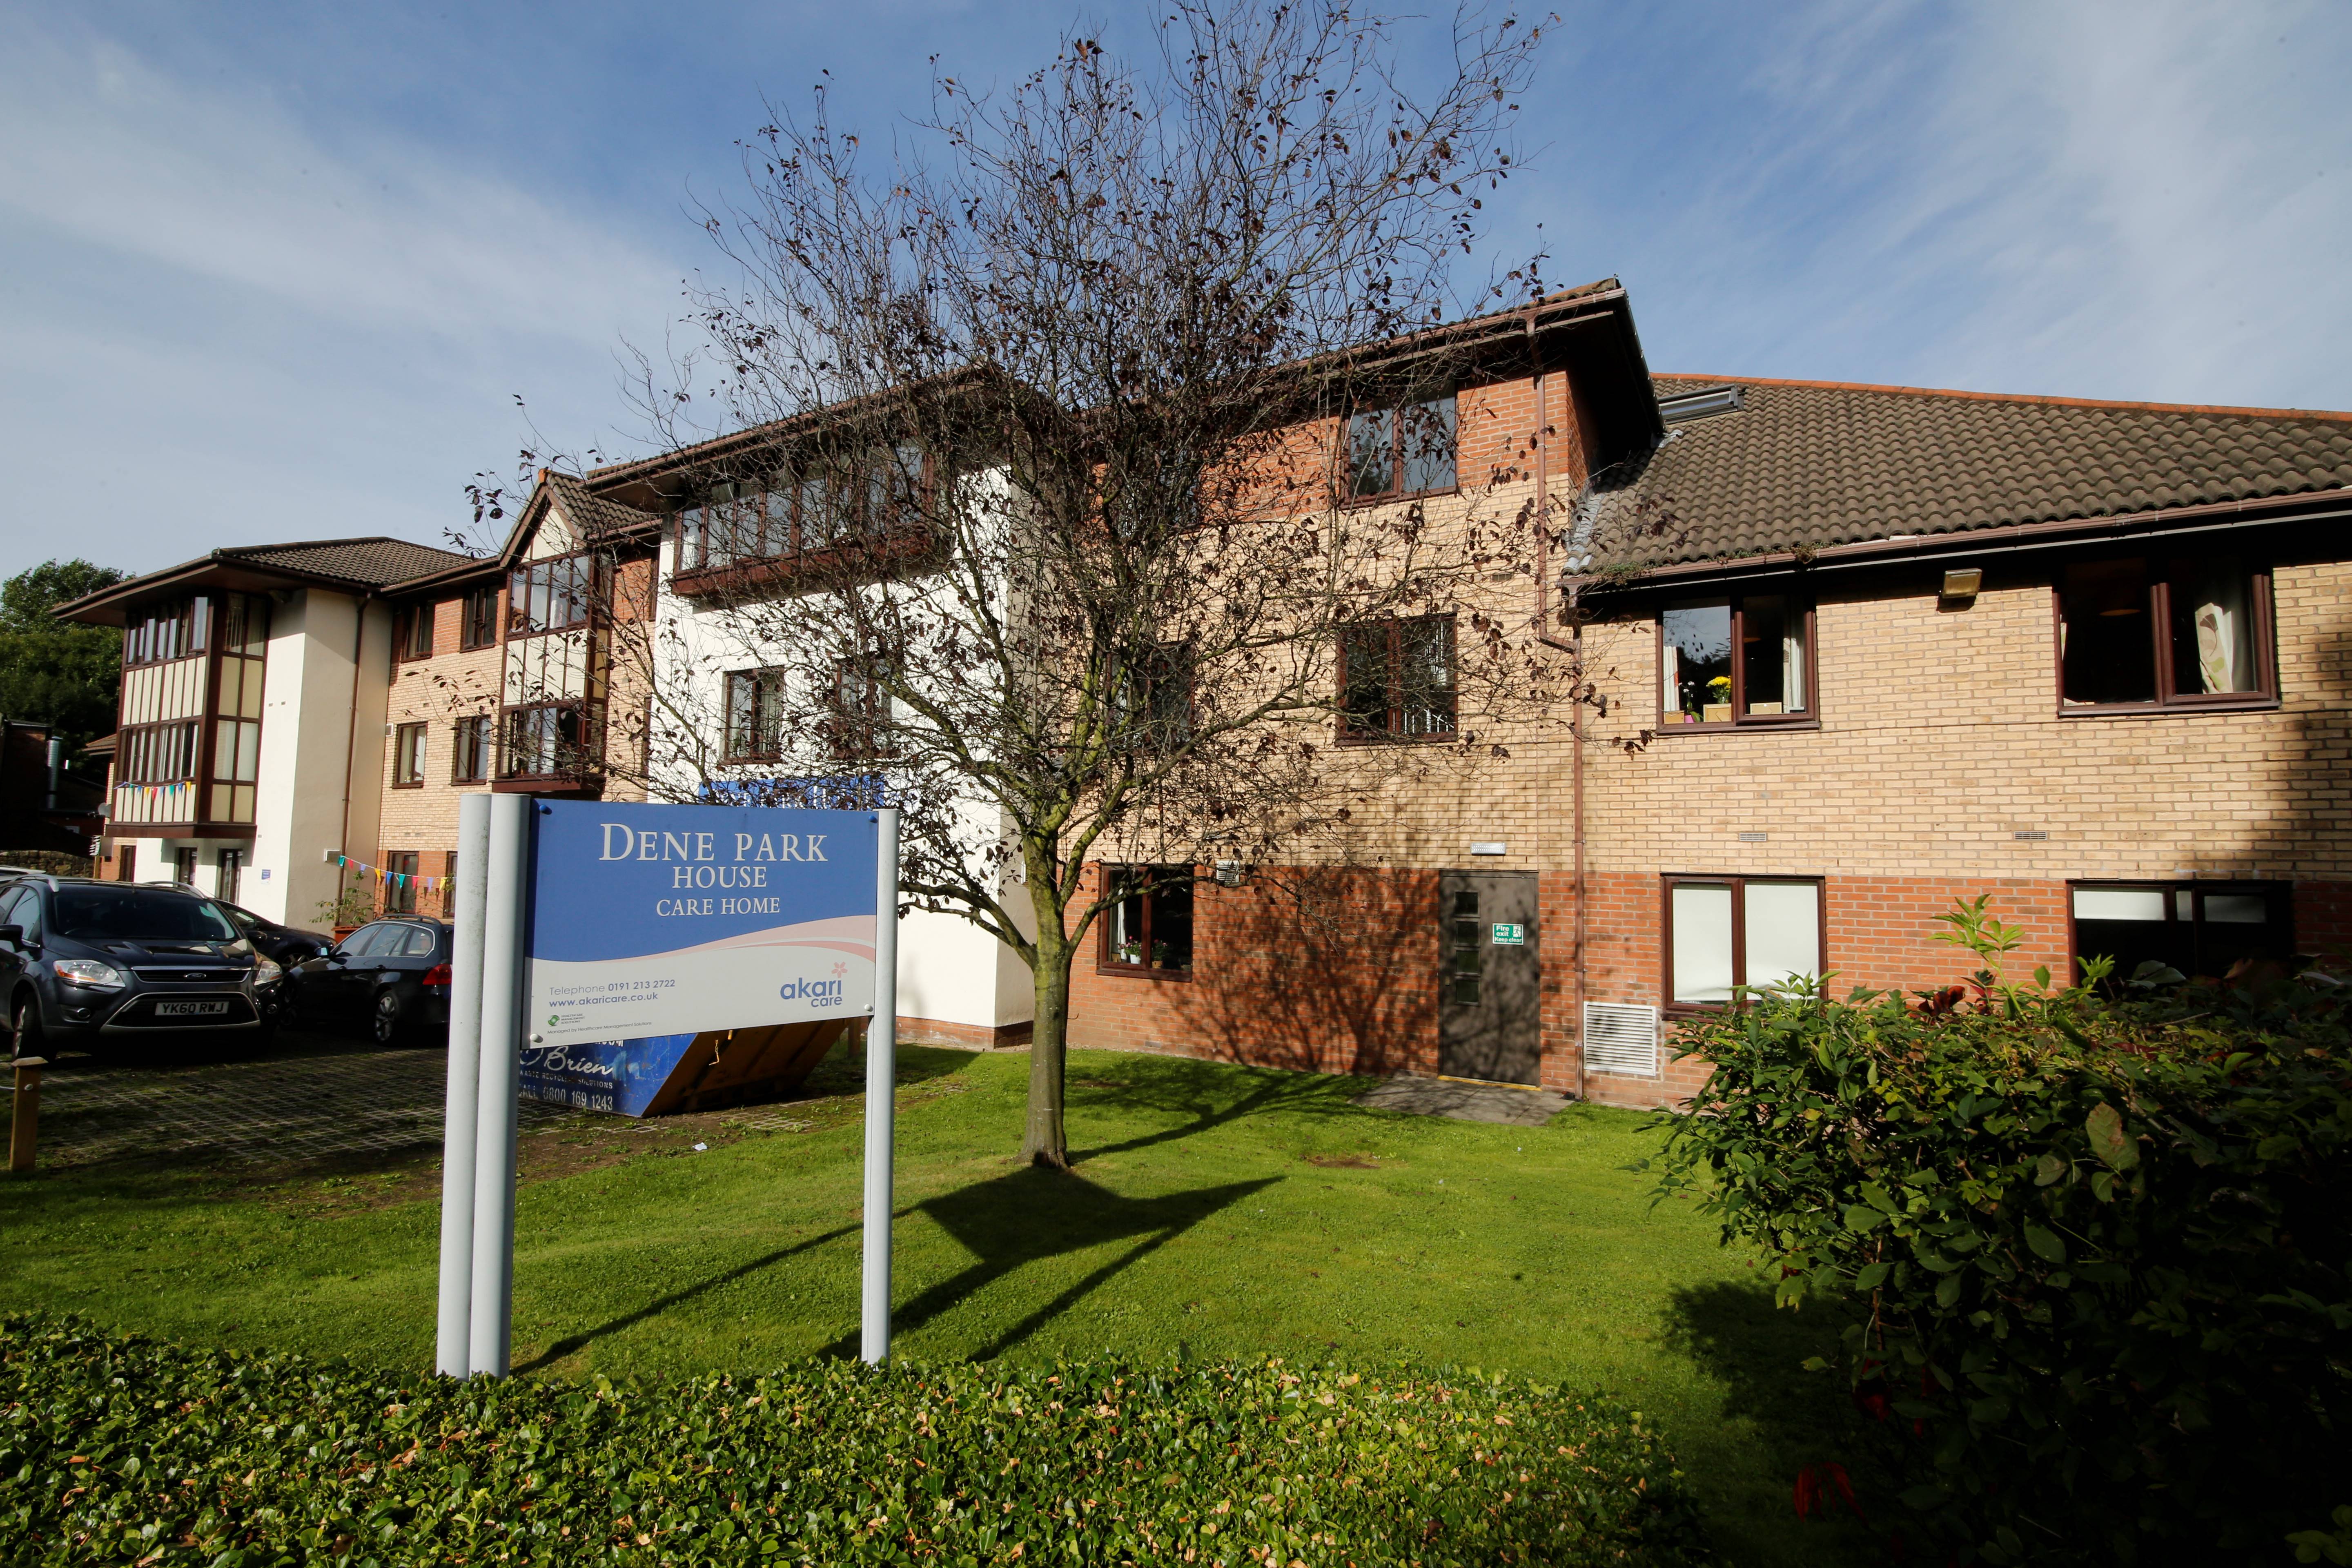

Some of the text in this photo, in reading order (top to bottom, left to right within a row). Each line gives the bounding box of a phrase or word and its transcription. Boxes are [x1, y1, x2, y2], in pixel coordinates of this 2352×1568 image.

[599, 823, 828, 862] DENE PARK
[672, 866, 767, 889] HOUSE
[656, 898, 780, 916] CARE HOME
[550, 979, 675, 995] Telephone 0191 213 2722
[780, 977, 842, 1000] akari
[163, 1003, 224, 1013] YK60 RWJ
[549, 992, 658, 1007] www.akaricare.co.uk
[811, 996, 842, 1007] care
[543, 1086, 566, 1102] 0800
[572, 1091, 587, 1106] 169
[592, 1094, 612, 1111] 1243
